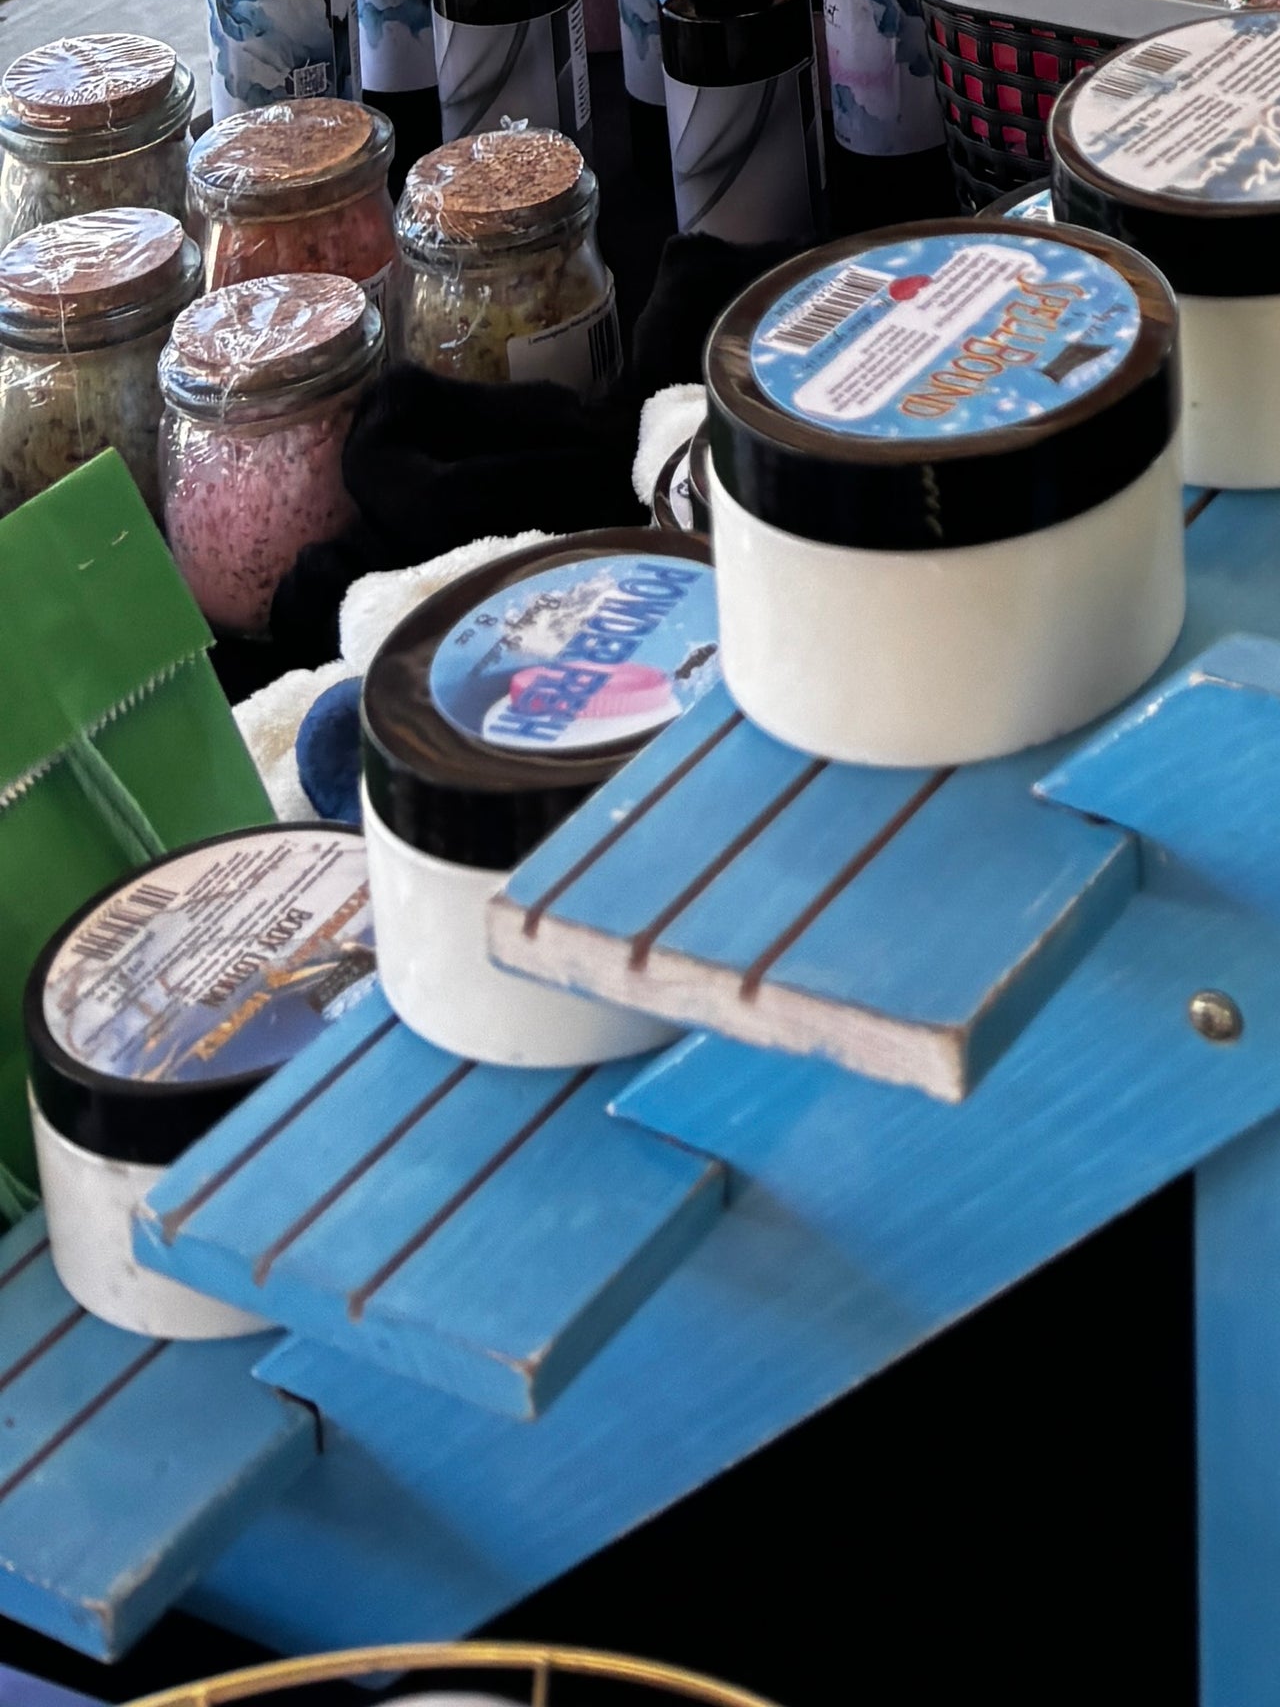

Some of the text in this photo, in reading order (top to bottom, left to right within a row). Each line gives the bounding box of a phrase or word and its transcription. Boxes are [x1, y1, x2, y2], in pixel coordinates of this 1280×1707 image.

[899, 272, 1087, 419] SPELLBOUND
[487, 562, 704, 742] POWDER FRESH
[198, 952, 269, 1007] LOTION
[260, 907, 313, 952] BODY
